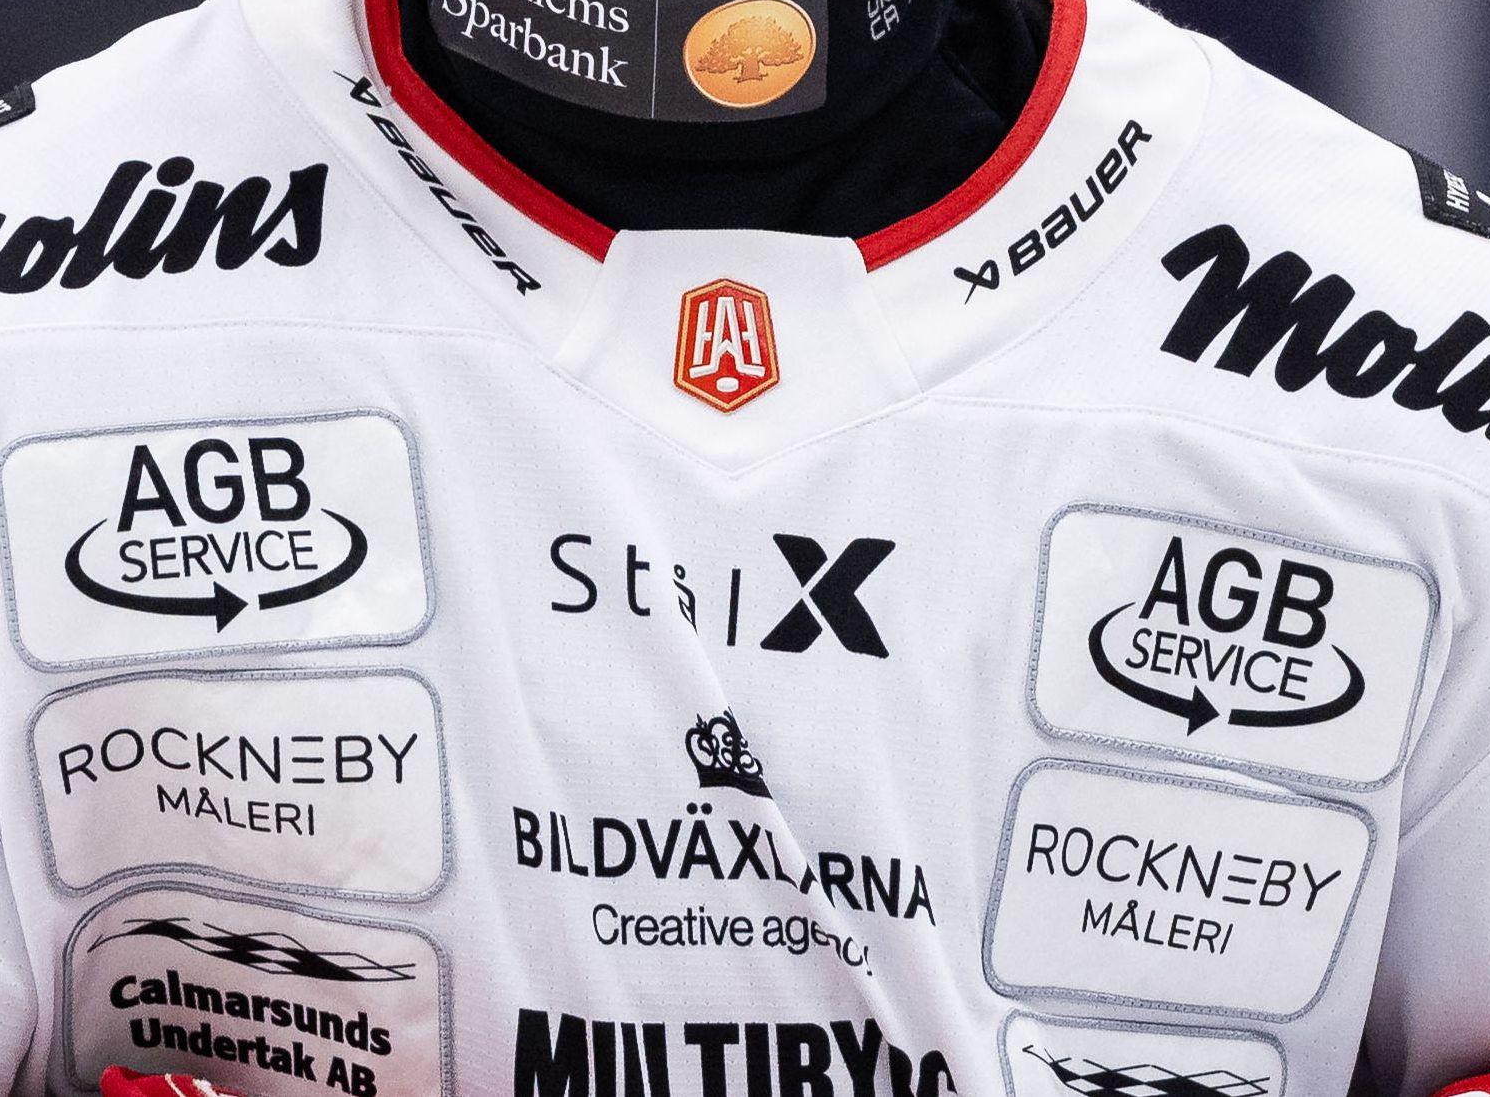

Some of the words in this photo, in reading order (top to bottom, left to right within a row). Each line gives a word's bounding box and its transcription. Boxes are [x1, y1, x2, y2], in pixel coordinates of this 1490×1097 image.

[870, 4, 901, 41] CA
[367, 112, 542, 297] BAUER
[1010, 119, 1153, 277] BAUER
[117, 437, 312, 534] AGB
[120, 530, 319, 584] SERVICE
[1138, 536, 1335, 649] AGB
[1124, 627, 1314, 702] SERVICE
[58, 727, 419, 796] ROCKNEBY
[156, 784, 316, 836] MÅLERI
[1026, 823, 1342, 912] ROCKNEBY
[592, 903, 754, 947] Creative
[1081, 898, 1234, 955] MÅLERI
[109, 969, 392, 1056] Calmarsunds
[128, 1018, 318, 1082] Undertak
[325, 1056, 378, 1097] AB
